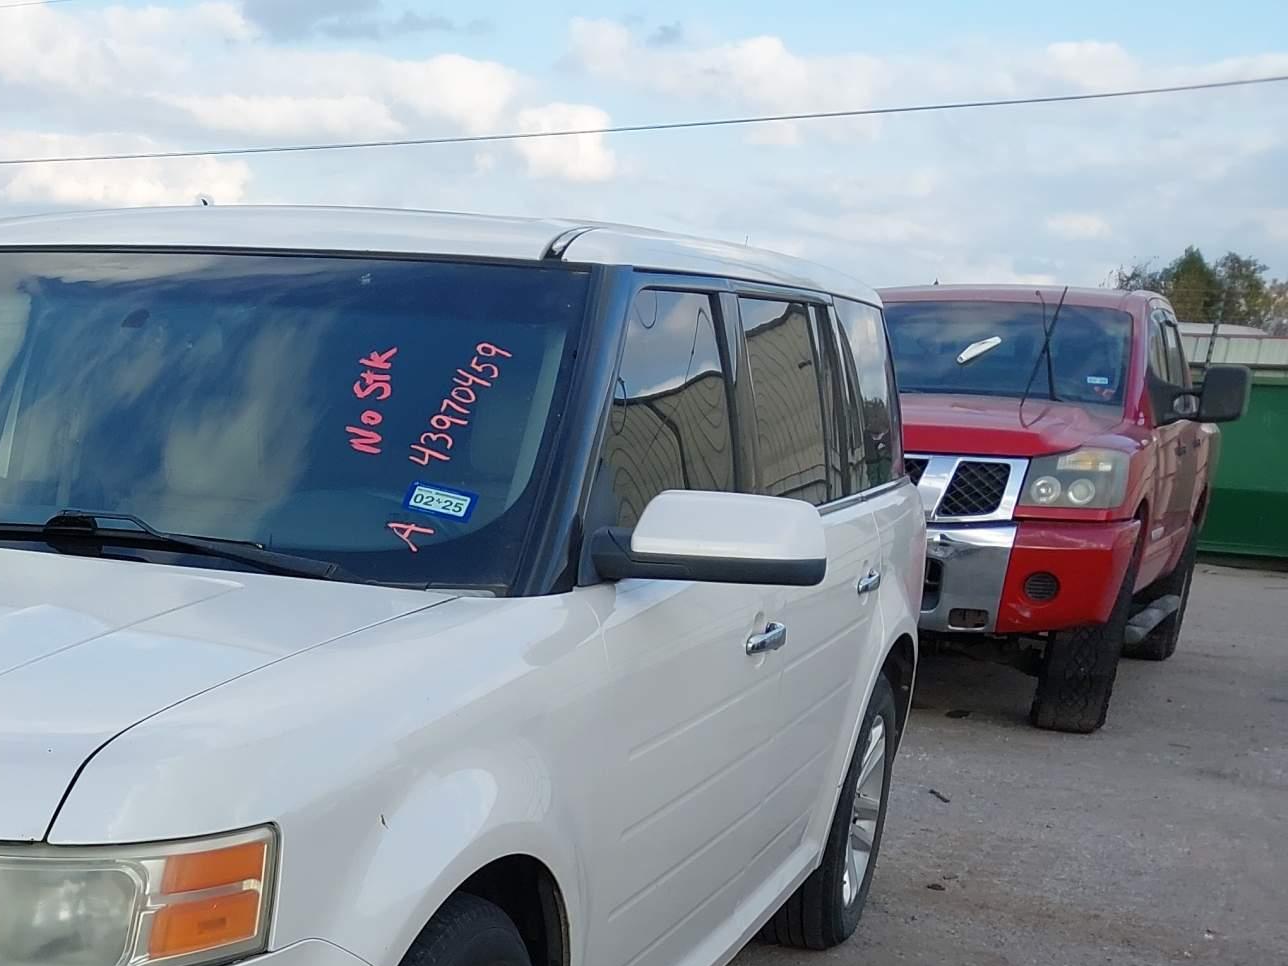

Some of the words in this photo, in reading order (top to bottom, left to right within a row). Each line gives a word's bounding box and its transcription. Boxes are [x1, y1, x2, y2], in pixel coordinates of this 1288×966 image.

[353, 347, 398, 400] Stk
[409, 342, 512, 466] 43970459
[345, 410, 383, 454] No
[387, 520, 434, 551] A
